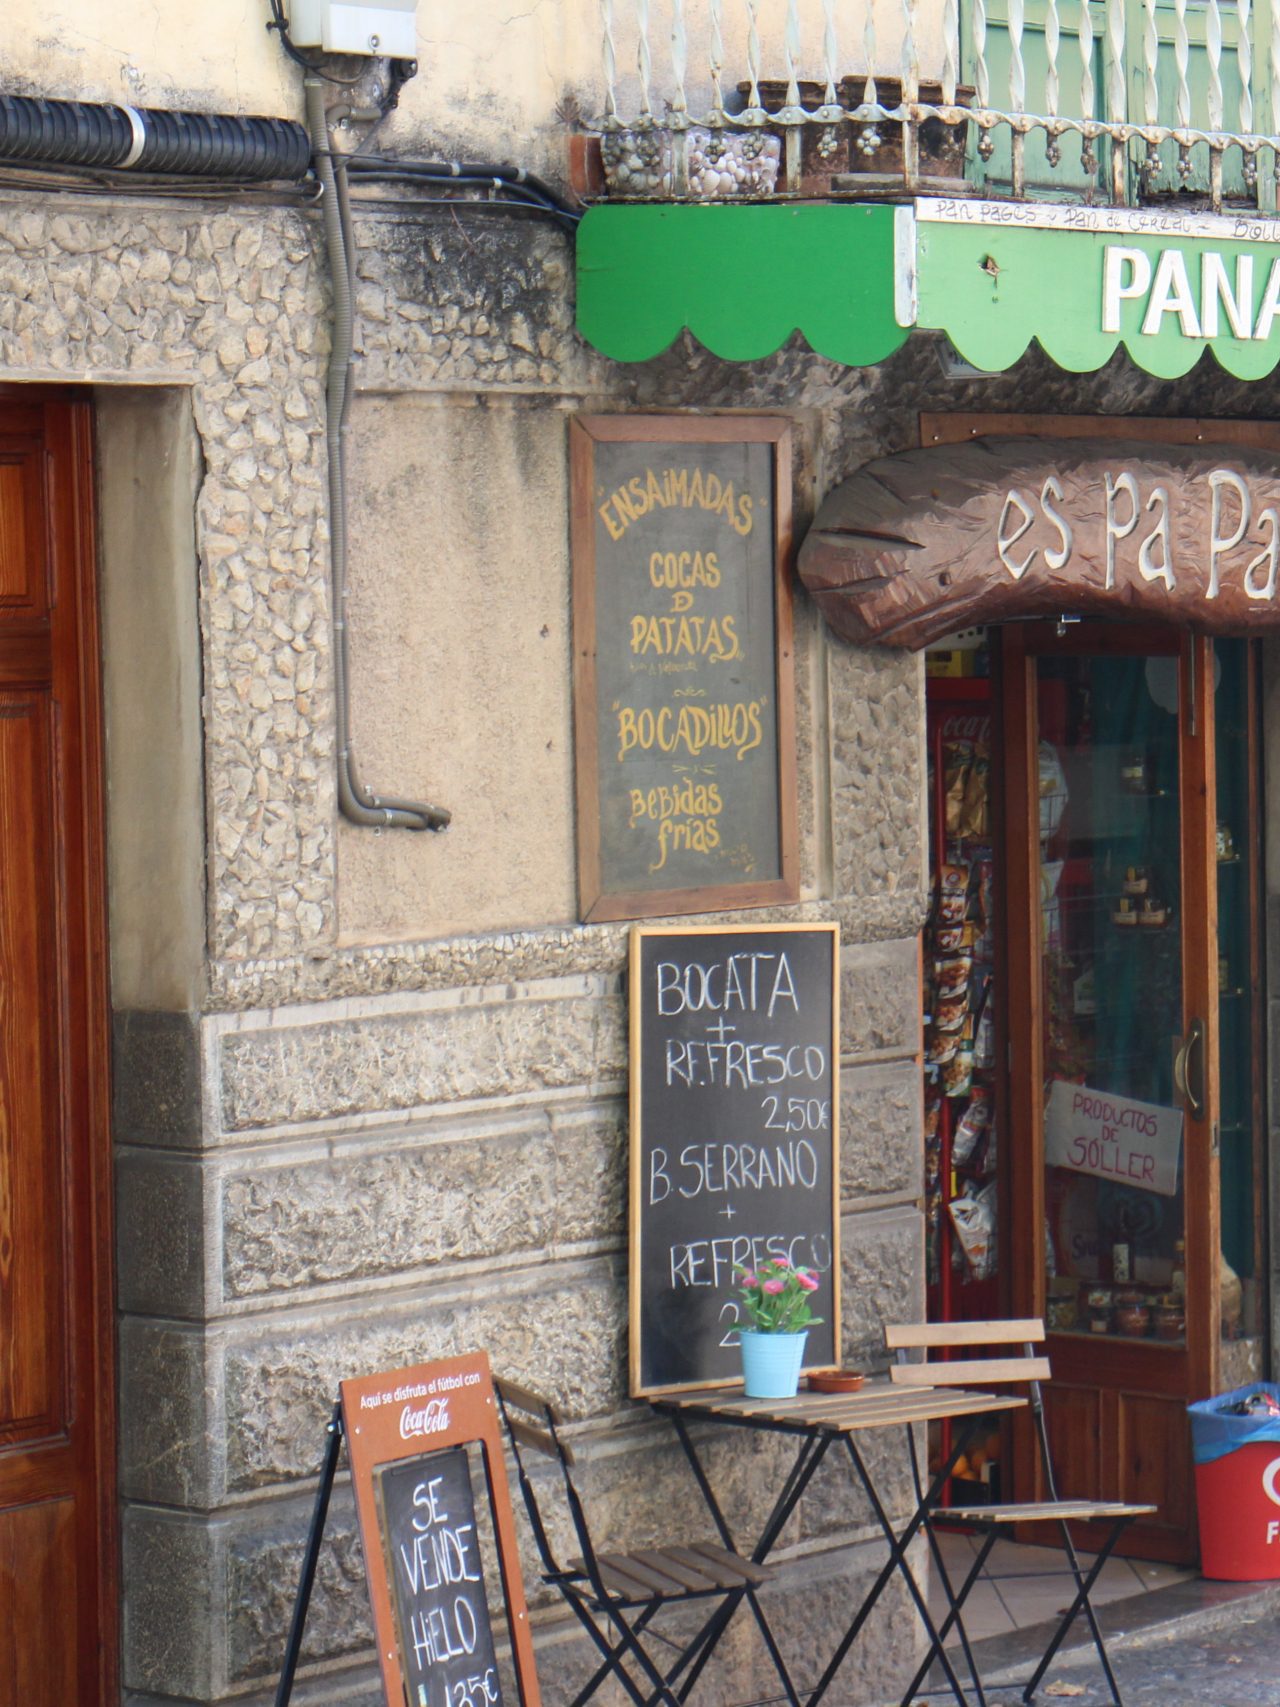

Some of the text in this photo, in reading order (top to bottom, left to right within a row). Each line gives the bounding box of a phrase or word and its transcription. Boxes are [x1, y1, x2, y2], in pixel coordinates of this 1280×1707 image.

[650, 551, 721, 589] COCAS
[630, 615, 740, 664] PATATAS
[657, 952, 799, 1018] BOCATA
[1072, 1092, 1158, 1137] PRODUCTOS
[1102, 1125, 1119, 1143] DE
[382, 1392, 393, 1404] se
[394, 1383, 427, 1402] disfruta
[428, 1381, 436, 1393] el
[464, 1373, 481, 1386] con
[412, 1476, 448, 1532] SE
[400, 1524, 480, 1595] VENDE
